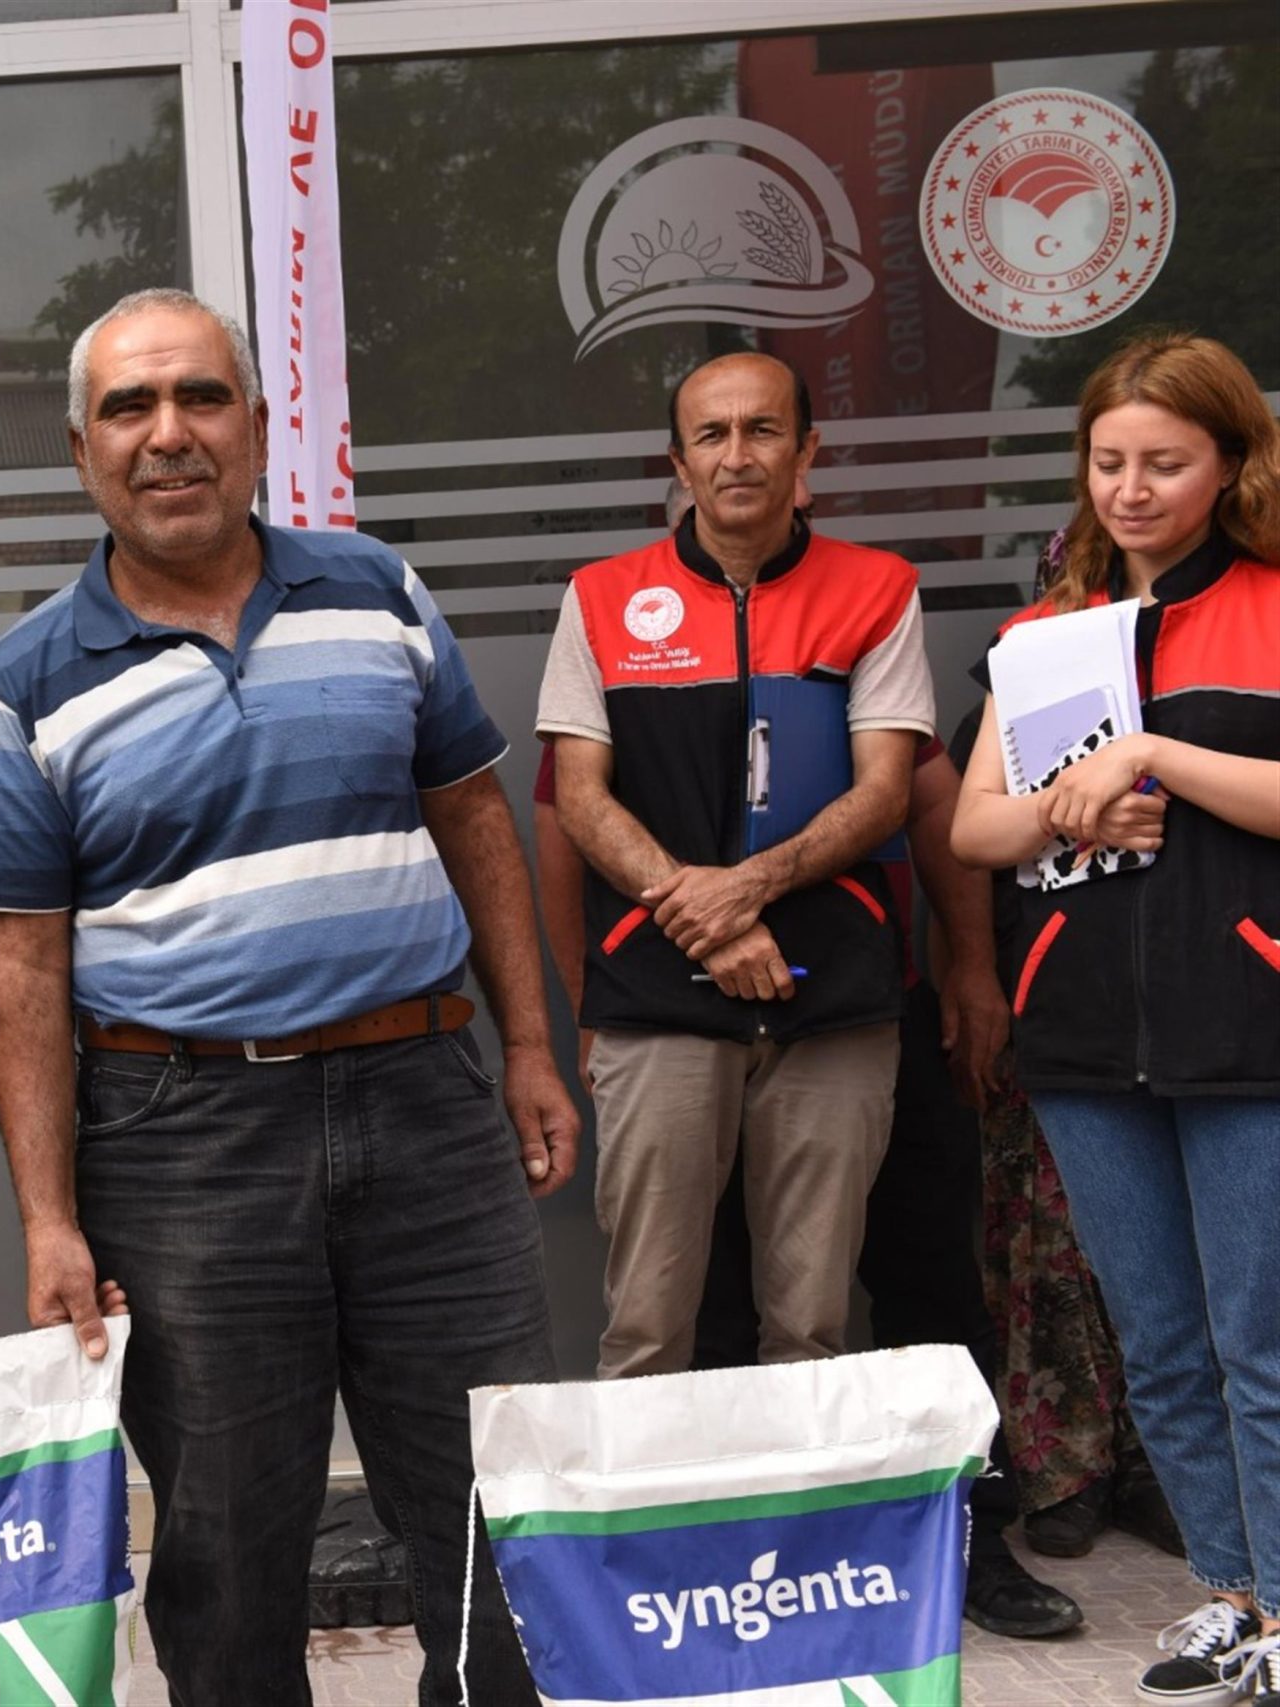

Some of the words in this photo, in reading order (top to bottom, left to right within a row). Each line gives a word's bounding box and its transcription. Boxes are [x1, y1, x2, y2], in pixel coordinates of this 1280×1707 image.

[1021, 135, 1072, 150] TARIM
[1075, 142, 1095, 160] VE
[968, 143, 1019, 242] CUMHURİYETİ
[1093, 157, 1127, 213] ORMAN
[979, 246, 1037, 290] TÜRKİYE
[627, 1557, 898, 1651] syngenta
